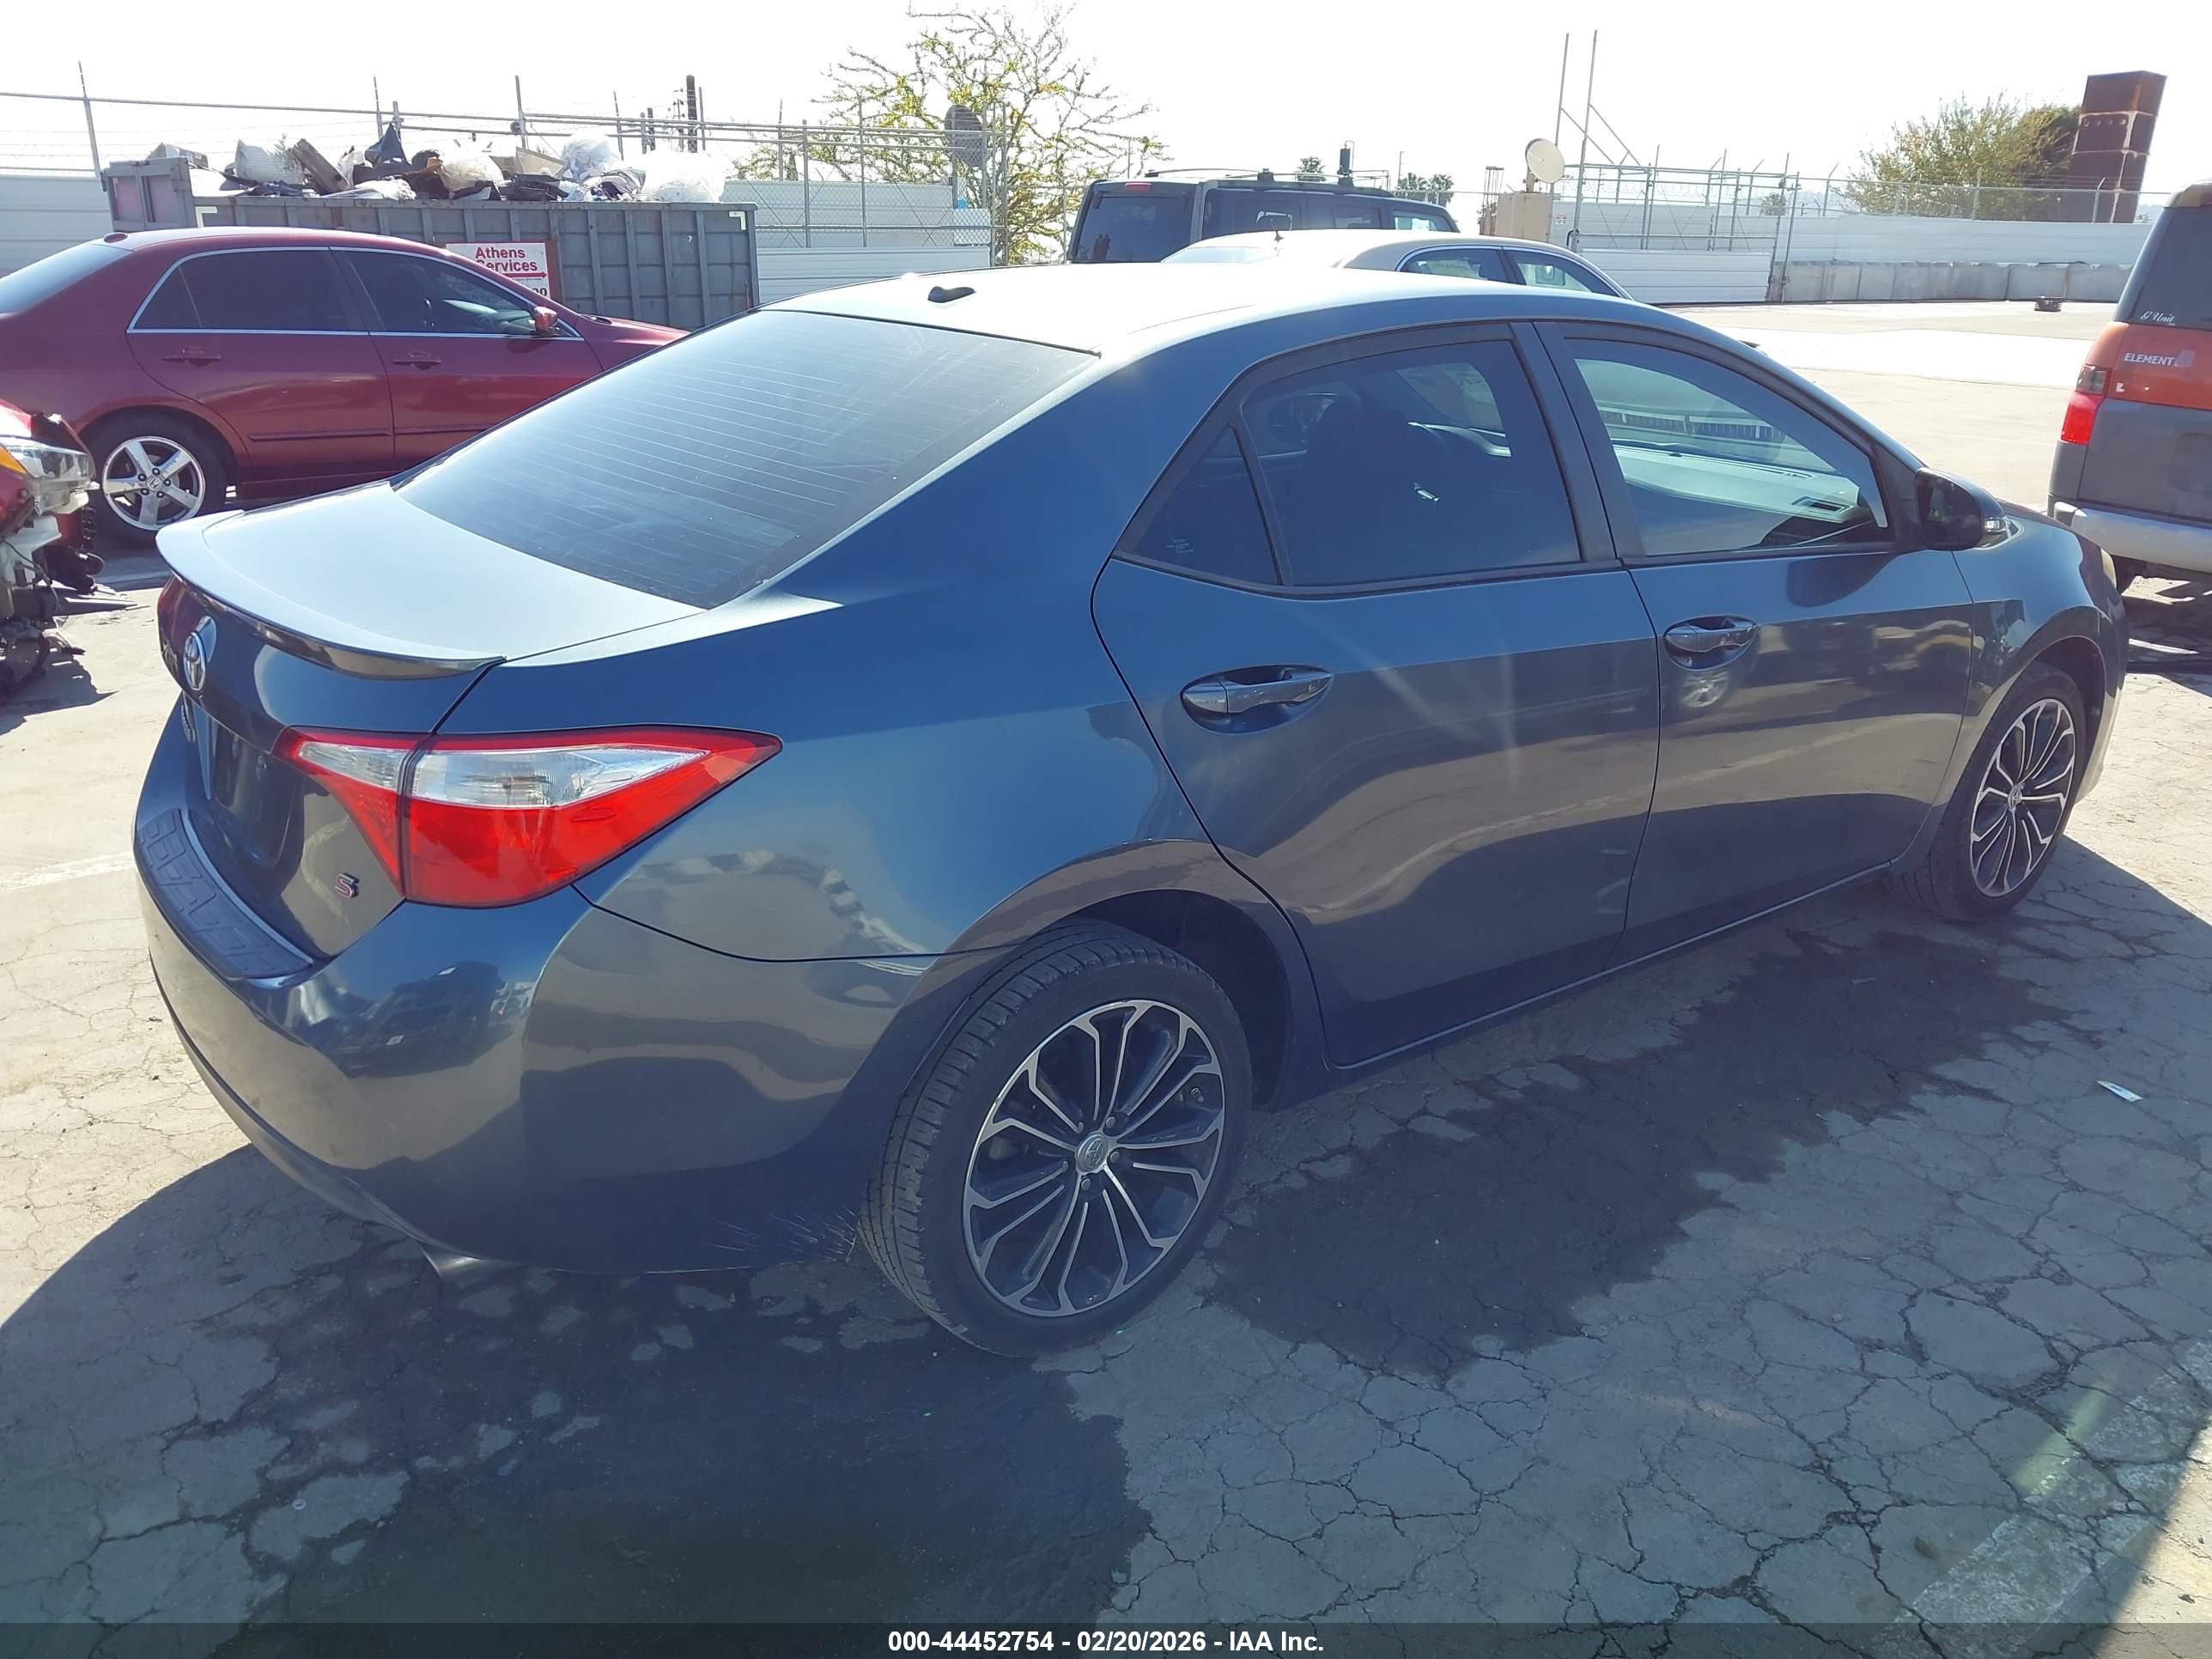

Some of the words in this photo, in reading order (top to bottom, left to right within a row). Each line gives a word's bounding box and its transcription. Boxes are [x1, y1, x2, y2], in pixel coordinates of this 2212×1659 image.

[475, 246, 526, 258] Athens
[2124, 353, 2175, 366] ELEMENT
[335, 872, 357, 899] S
